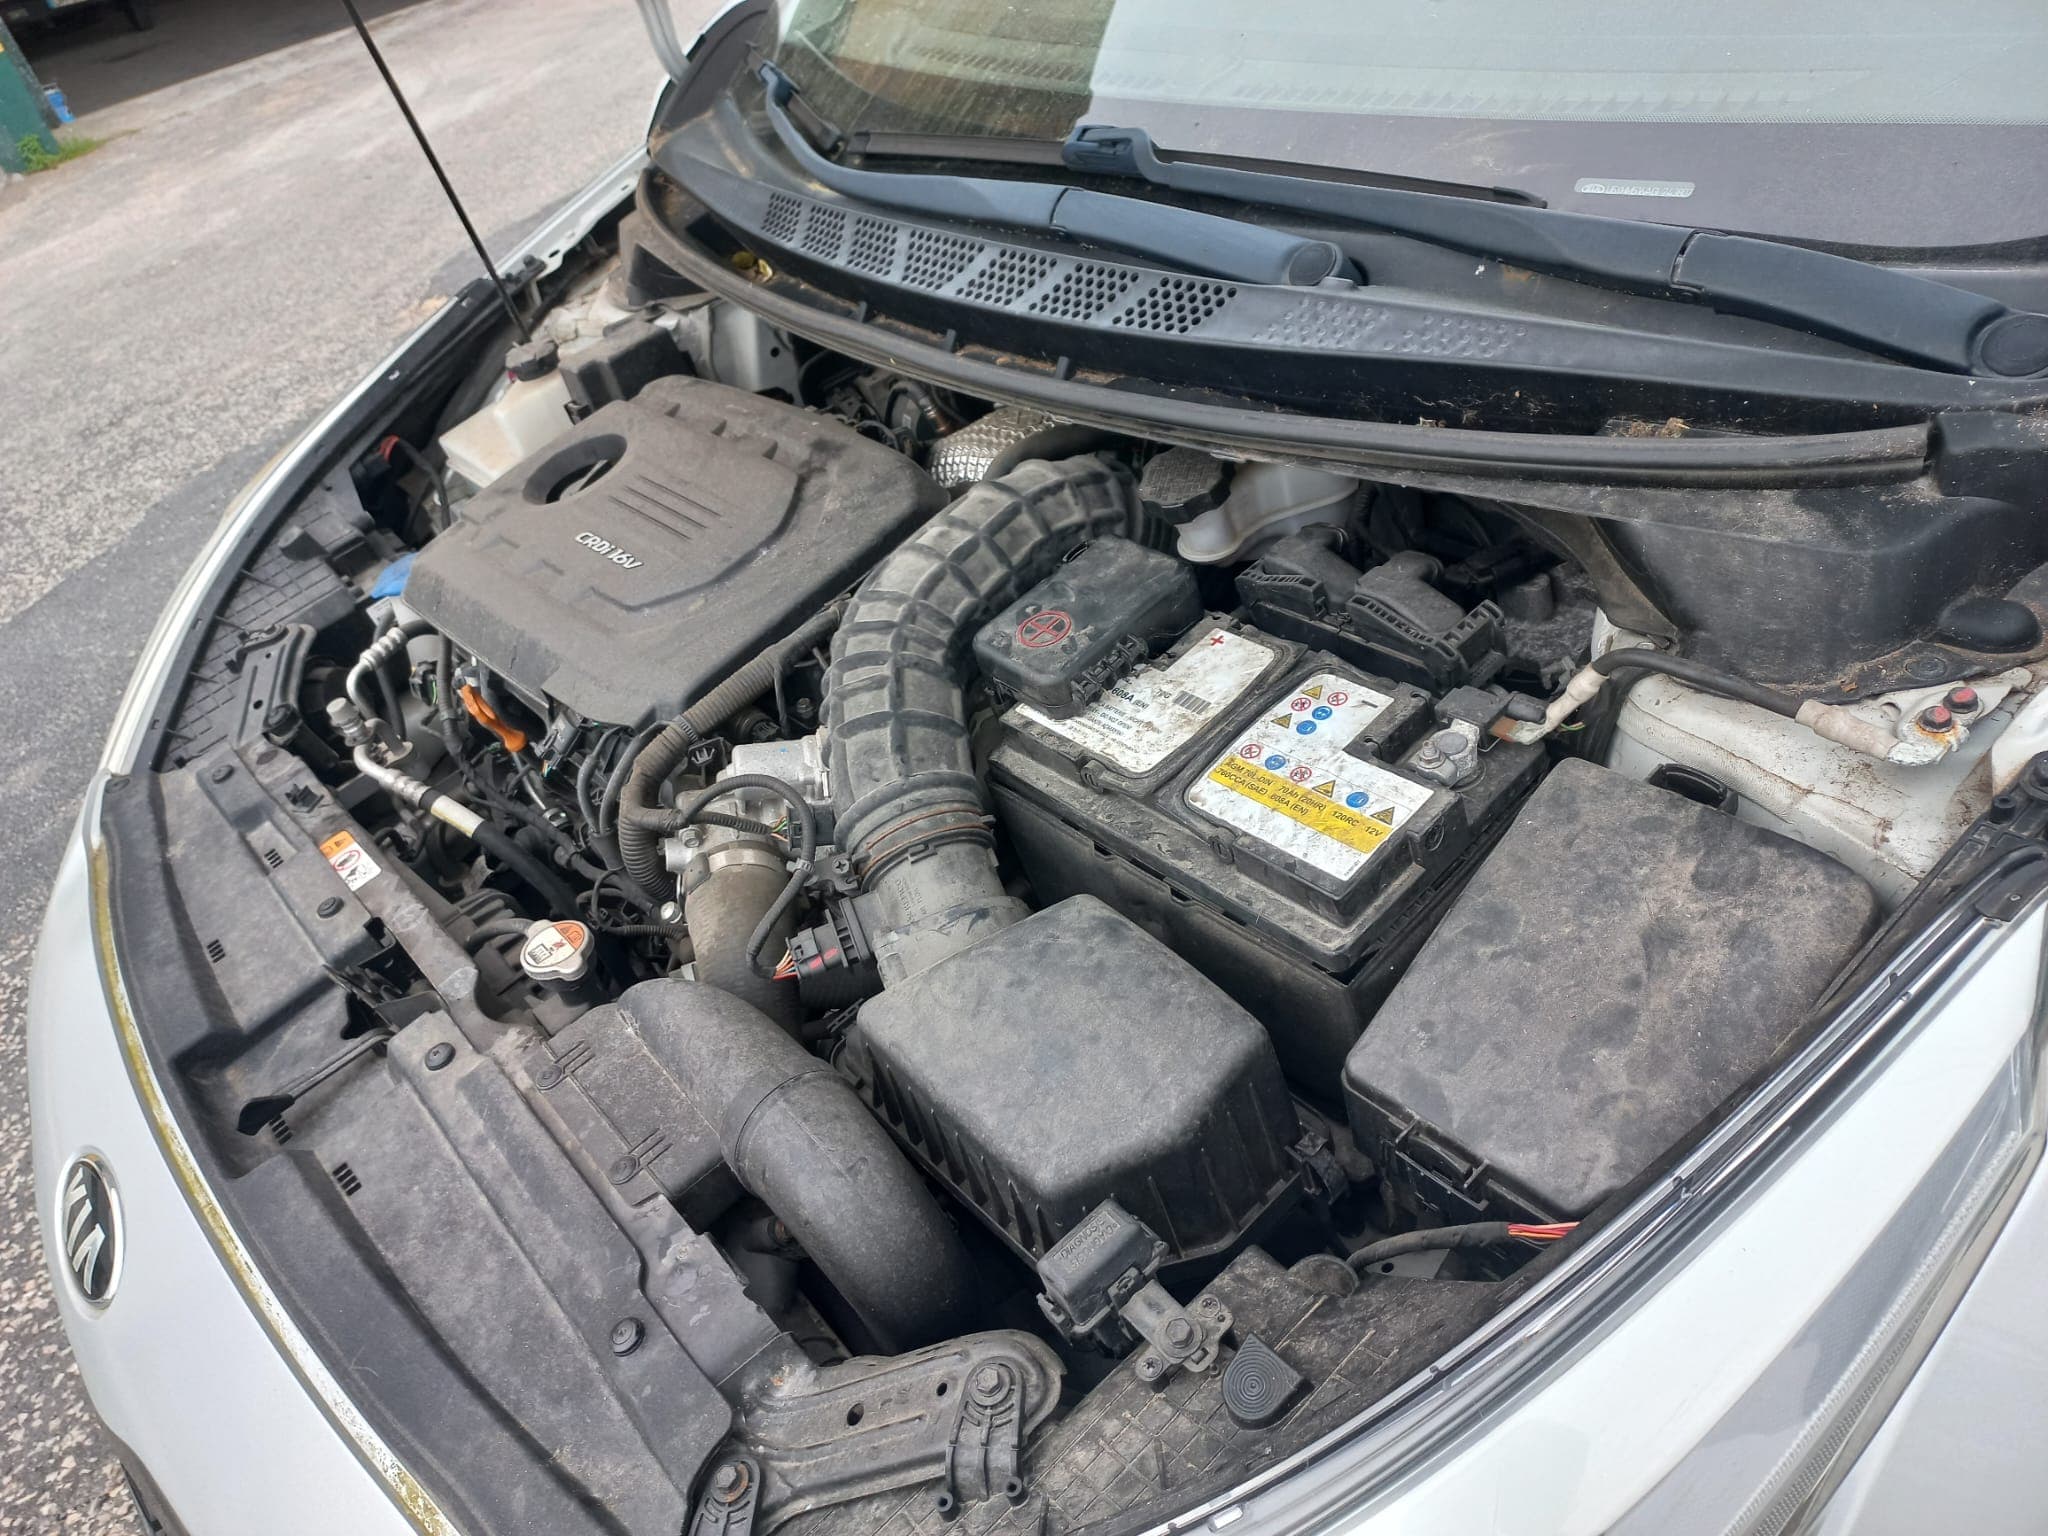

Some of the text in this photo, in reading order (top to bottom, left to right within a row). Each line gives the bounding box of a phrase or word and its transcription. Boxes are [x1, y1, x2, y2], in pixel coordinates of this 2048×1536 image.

[575, 531, 643, 570] CRDi 16V
[1245, 781, 1269, 796] (SAE)
[1289, 803, 1310, 817] (EN)
[1278, 785, 1299, 799] 70Ah
[1299, 793, 1328, 811] (20HR)
[1332, 810, 1361, 827] 120RC
[1365, 825, 1385, 837] 12V
